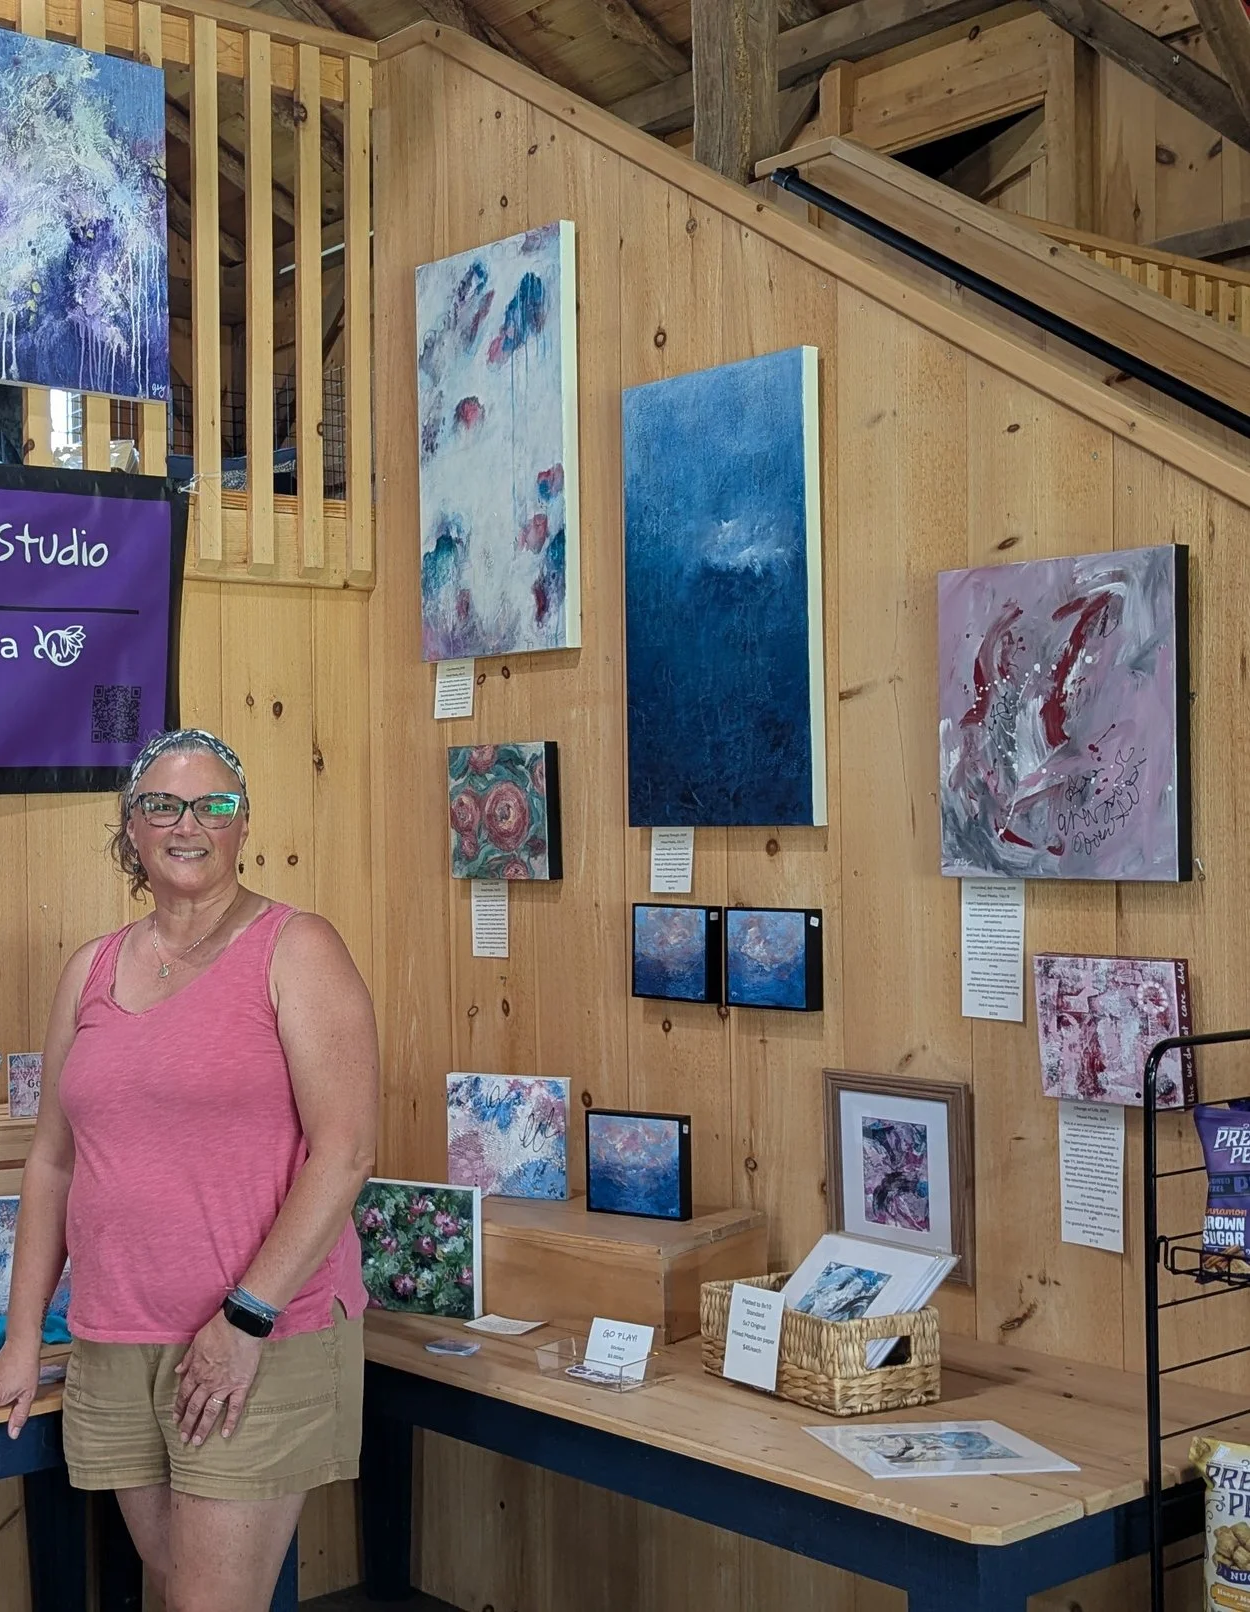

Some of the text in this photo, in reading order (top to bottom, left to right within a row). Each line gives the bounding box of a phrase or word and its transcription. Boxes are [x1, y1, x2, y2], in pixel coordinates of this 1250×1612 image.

[1203, 1231, 1245, 1247] SUGAR
[746, 1309, 765, 1318] Standard
[751, 1322, 766, 1331] Original
[618, 1332, 638, 1342] PLAY!
